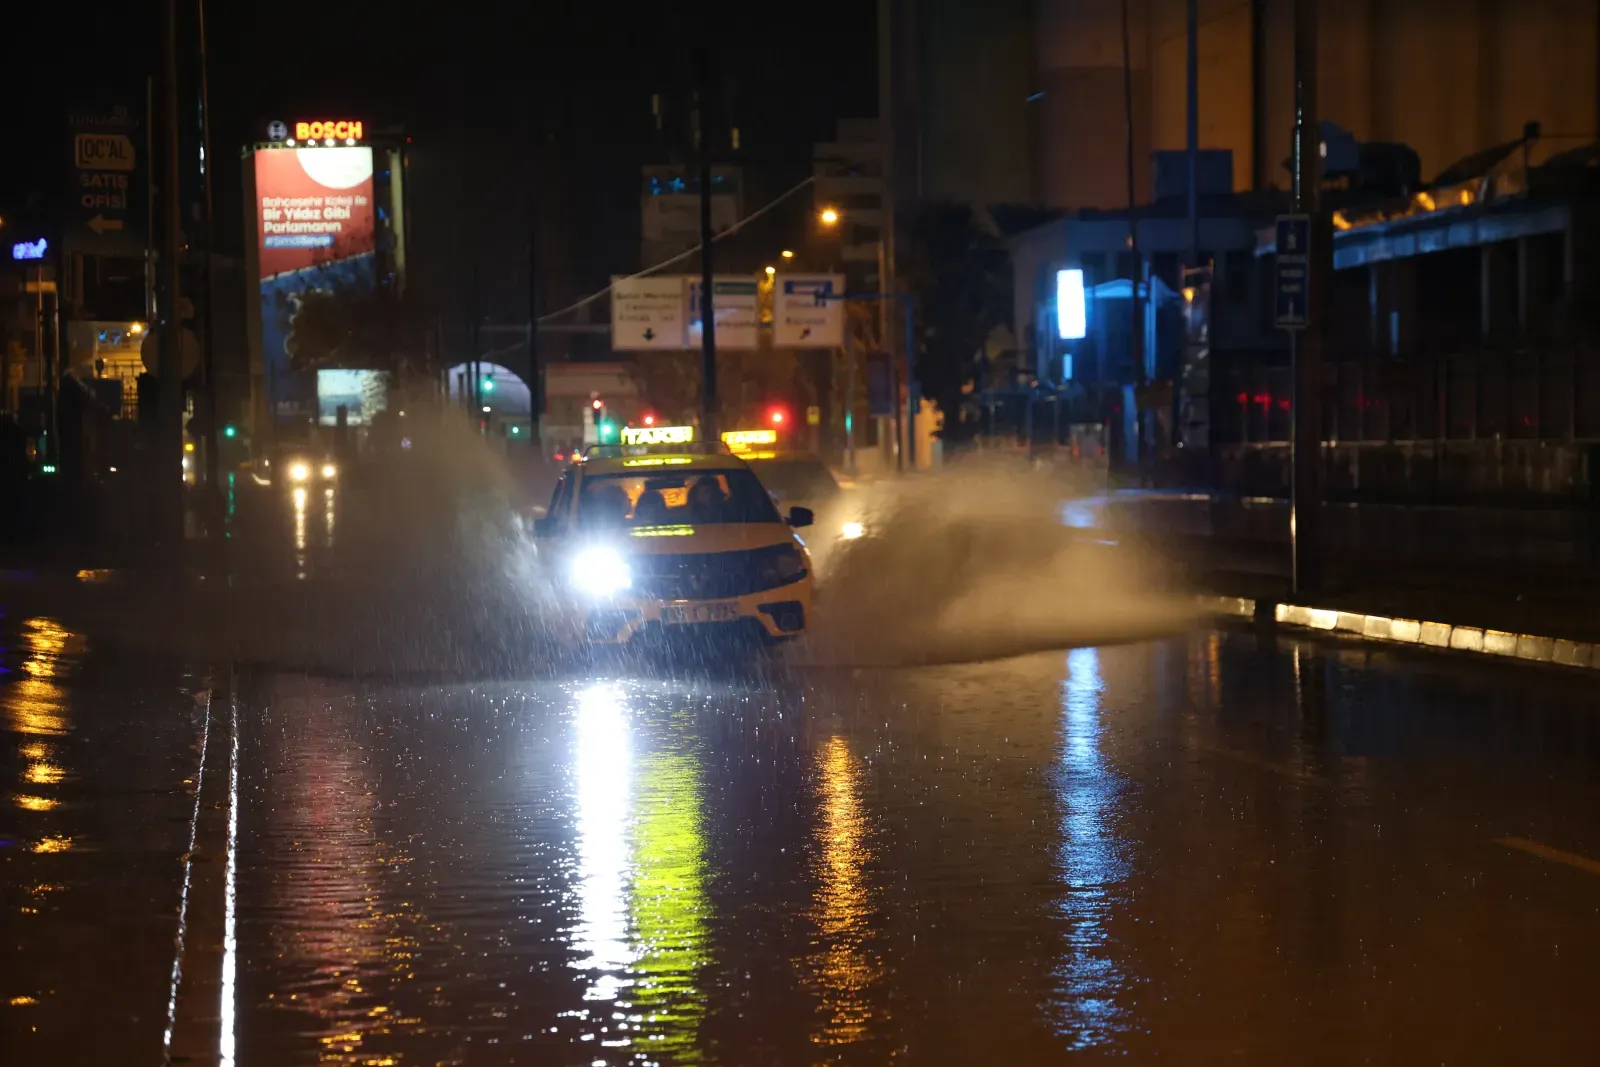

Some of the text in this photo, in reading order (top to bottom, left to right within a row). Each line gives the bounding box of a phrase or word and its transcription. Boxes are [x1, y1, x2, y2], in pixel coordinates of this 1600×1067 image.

[296, 121, 363, 140] BOSCH
[263, 208, 282, 220] Bir
[323, 206, 351, 220] Gibi
